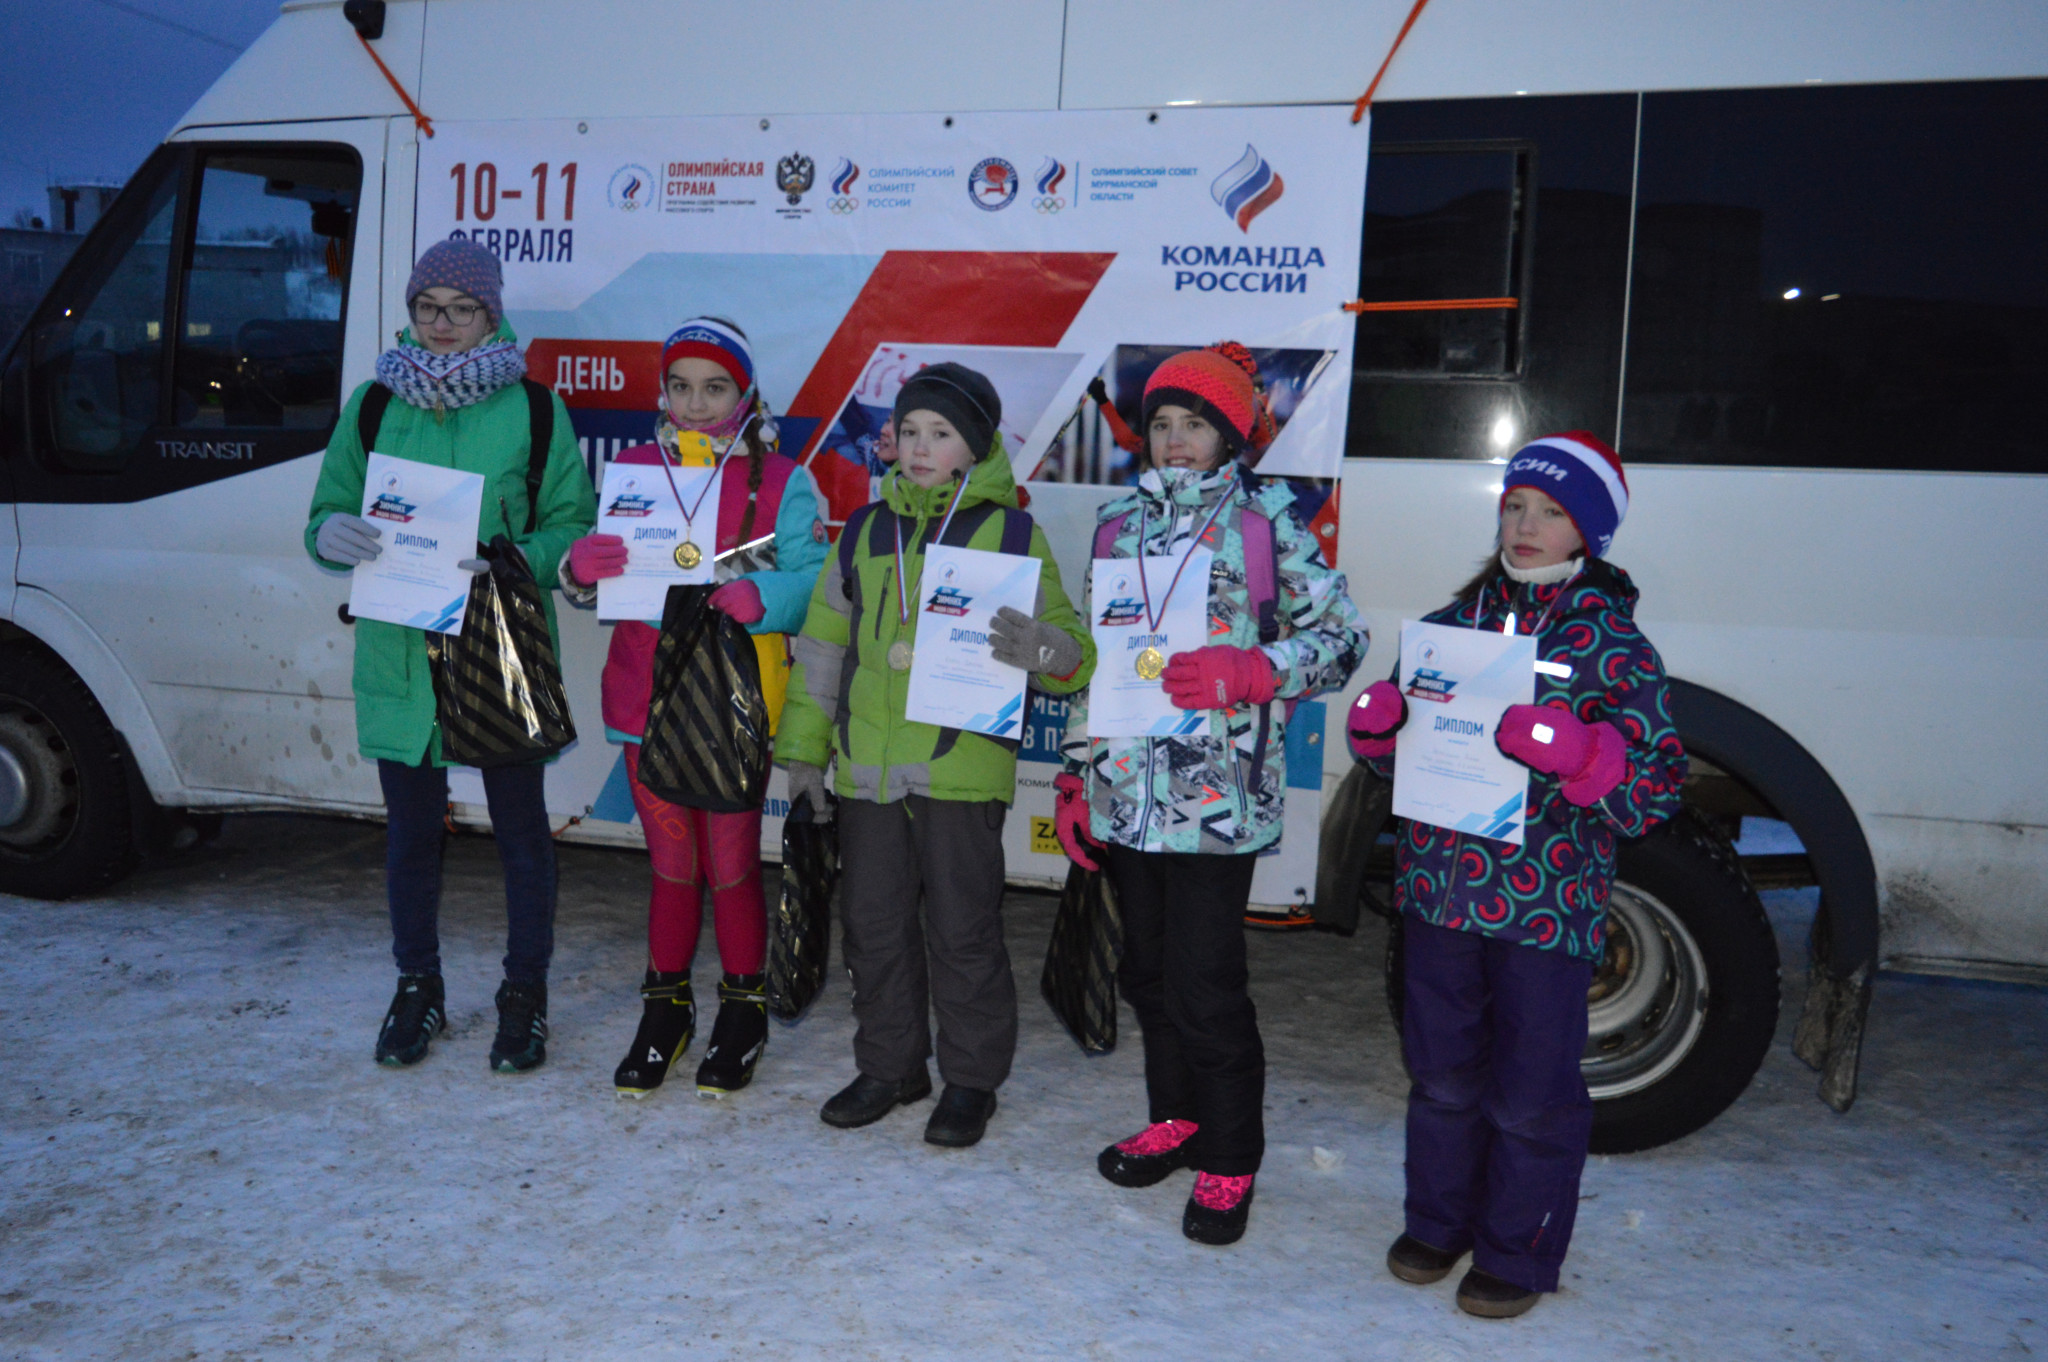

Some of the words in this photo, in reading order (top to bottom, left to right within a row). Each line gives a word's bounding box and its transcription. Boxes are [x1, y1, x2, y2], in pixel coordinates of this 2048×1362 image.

[668, 158, 764, 177] ОЛИМПИЙСКАЯ
[868, 166, 955, 178] ОЛИМПИЙСКИЙ
[1091, 166, 1166, 177] ОЛИМПИЙСКИЙ
[1168, 167, 1198, 177] СОВЕТ
[667, 181, 716, 196] СТРАНА
[867, 183, 916, 193] КОМИТЕТ
[1090, 179, 1158, 189] МУРМАНСКОЙ
[867, 198, 912, 208] РОССИИ
[1090, 192, 1134, 201] ОБЛАСТИ
[1161, 245, 1326, 270] КОМАНДА
[1174, 271, 1308, 293] РОССИИ
[554, 355, 626, 395] ДЕНЬ
[155, 440, 257, 460] TRANSIT
[394, 532, 438, 550] ДИПЛОМ
[633, 527, 677, 540] ДИПЛОМ
[1127, 634, 1168, 650] ДИПЛОМ
[1434, 715, 1484, 737] ДИПЛОМ
